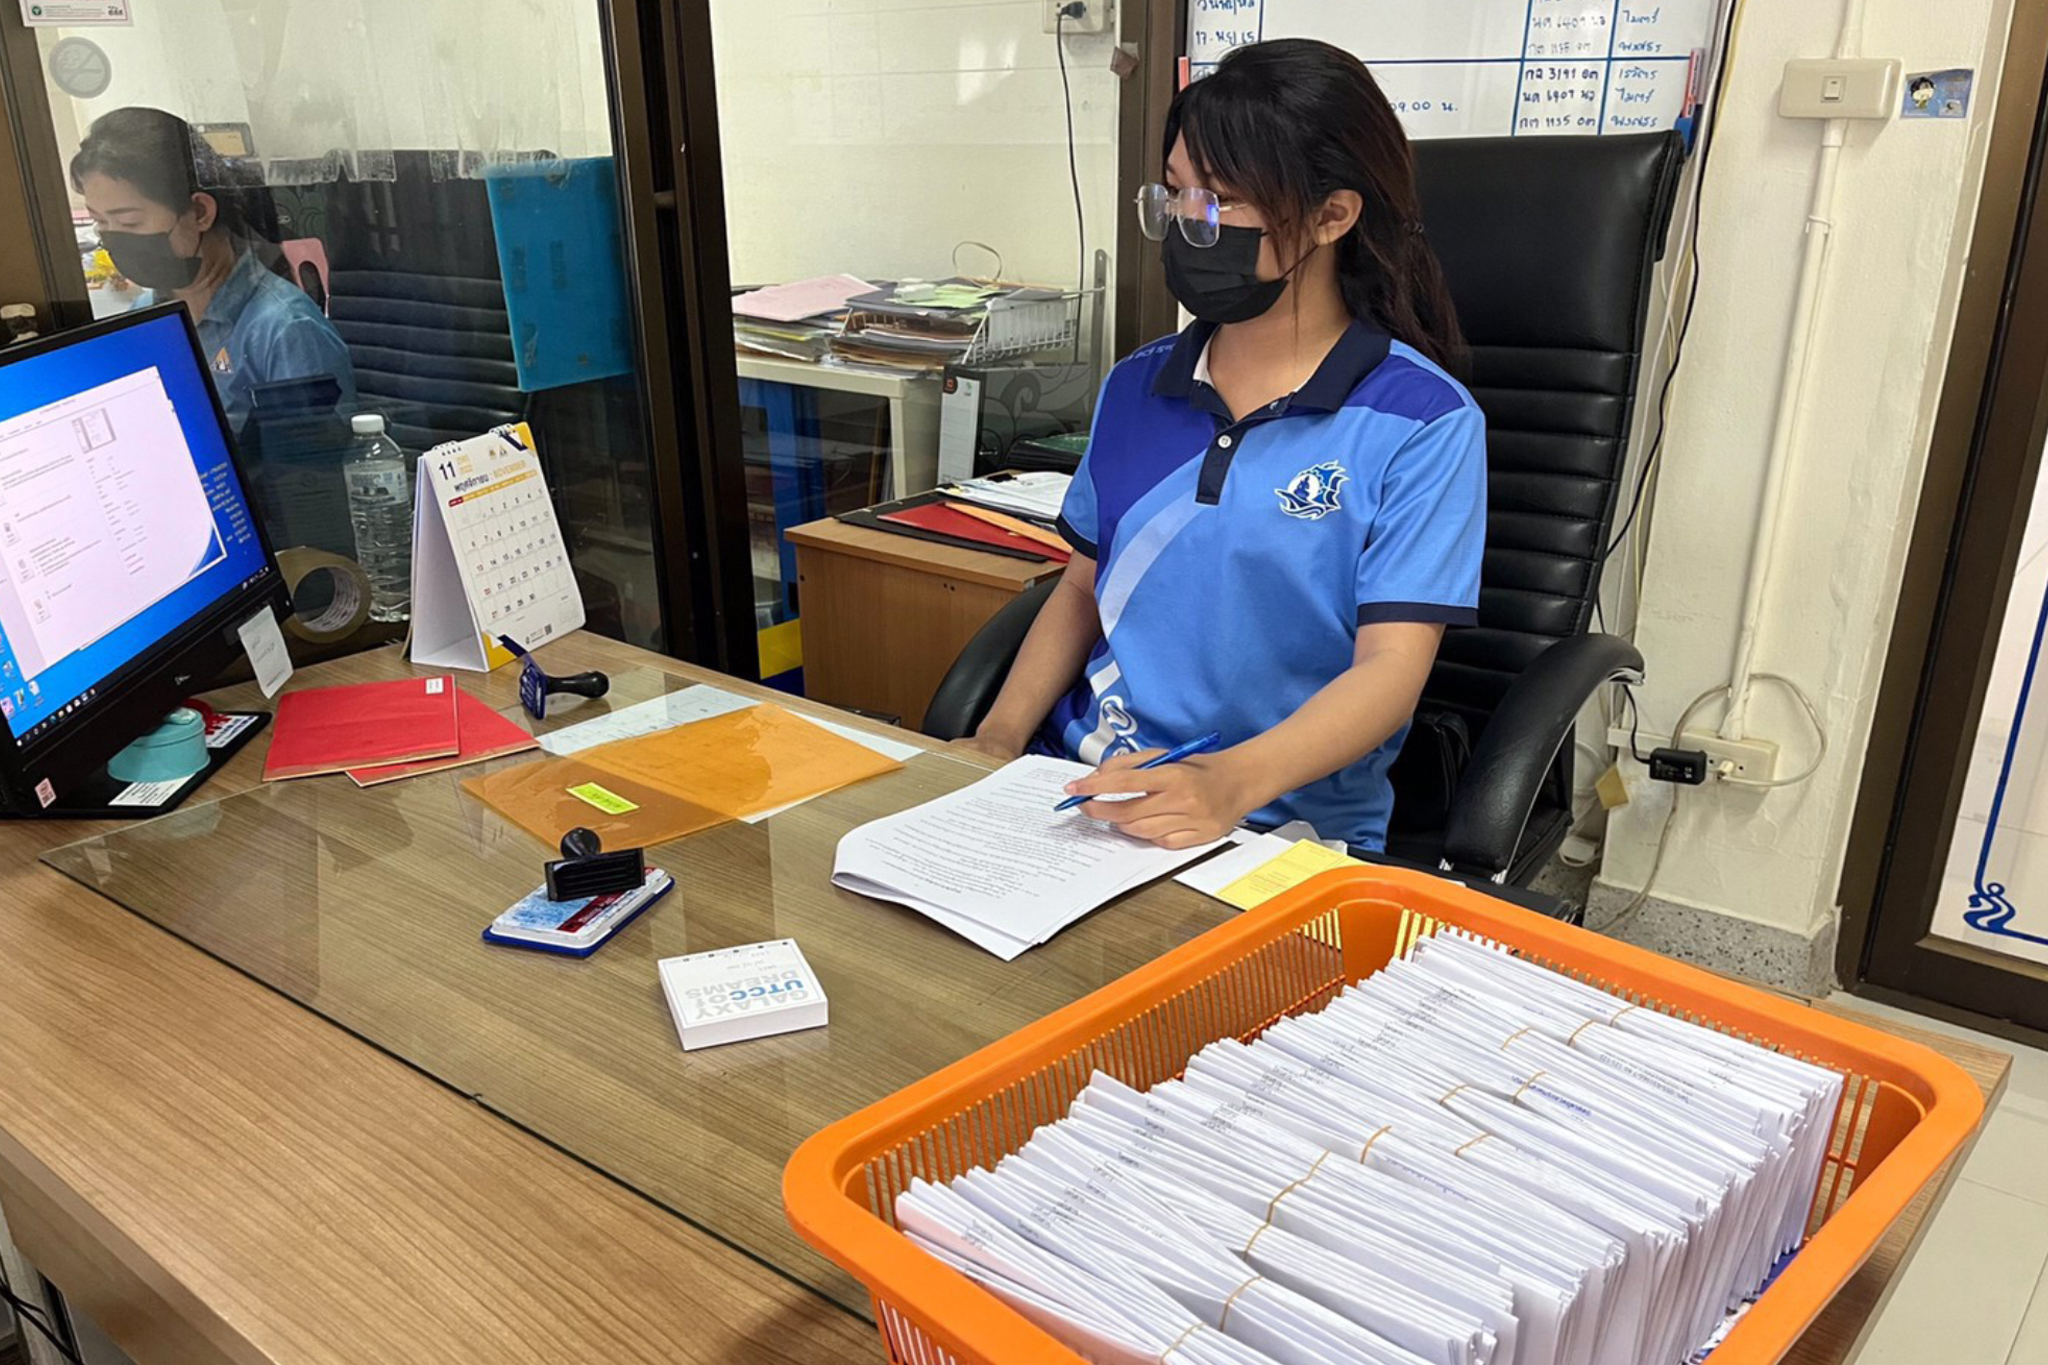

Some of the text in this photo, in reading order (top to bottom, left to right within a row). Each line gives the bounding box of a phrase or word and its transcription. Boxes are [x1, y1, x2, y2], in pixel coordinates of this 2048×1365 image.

[439, 461, 456, 480] 11
[685, 970, 799, 999] DREAMS
[729, 979, 804, 1001] UTCC
[696, 989, 809, 1020] GALAXY
